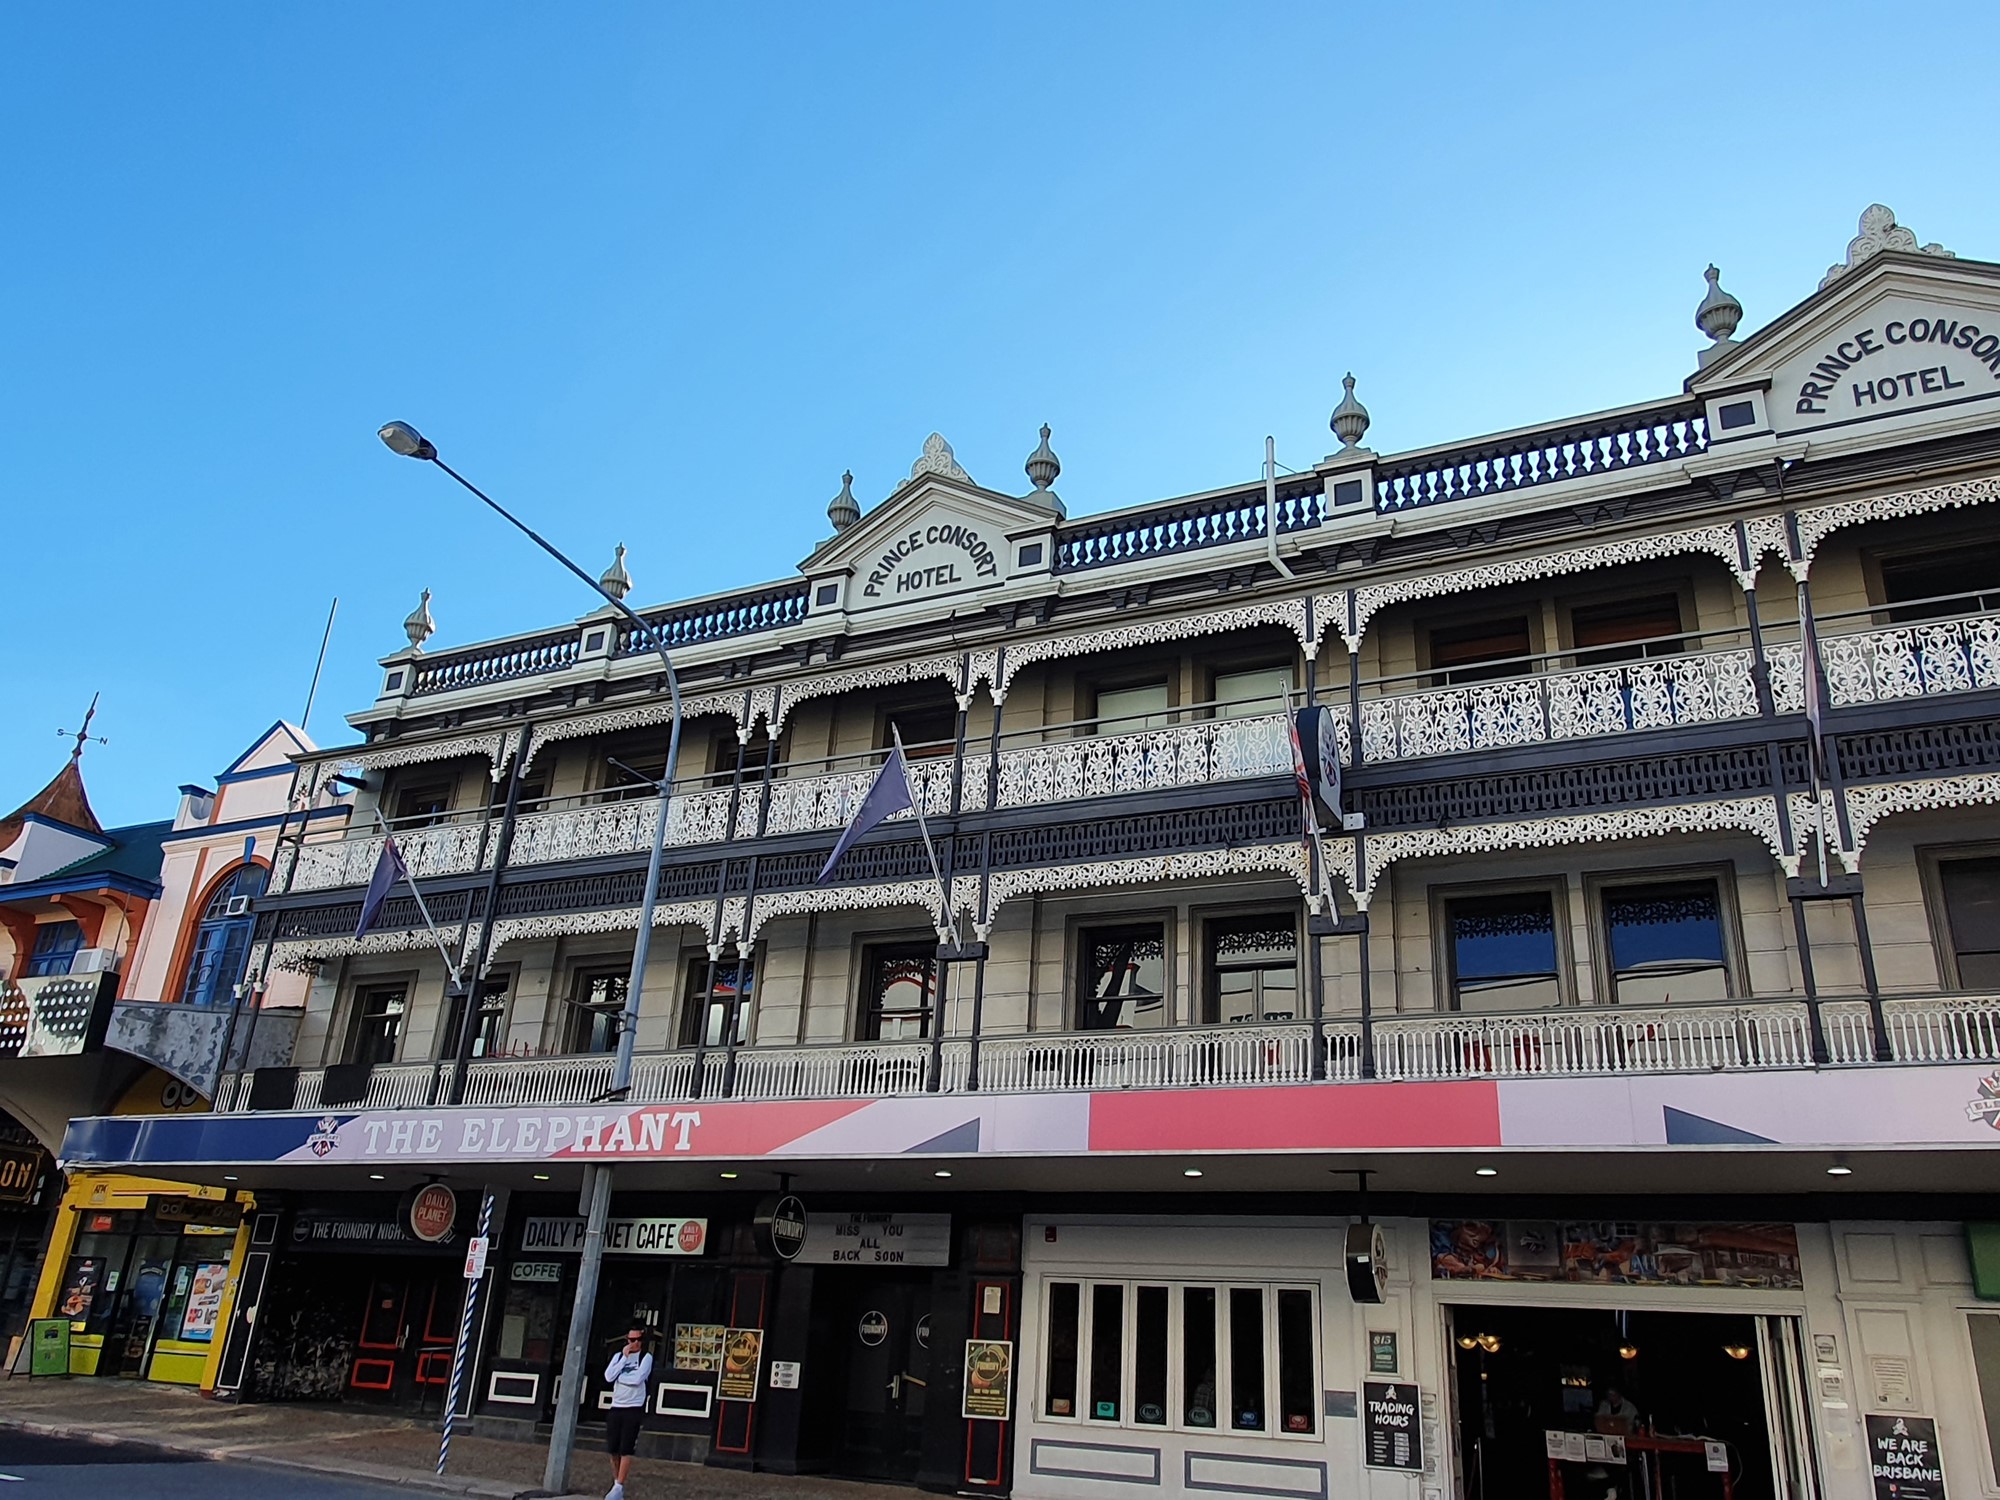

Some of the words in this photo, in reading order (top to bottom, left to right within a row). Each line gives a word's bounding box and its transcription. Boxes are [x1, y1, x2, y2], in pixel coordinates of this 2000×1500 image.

[1795, 328, 1884, 414] PRINCE
[1885, 318, 2000, 380] CONSO
[1853, 366, 1965, 407] HOTEL
[863, 530, 924, 597] PRINCE
[926, 524, 997, 578] CONSORT
[896, 564, 962, 593] HOTEL
[363, 1119, 444, 1155] THE
[459, 1111, 701, 1155] ELEPHANT
[0, 1160, 33, 1188] ON
[425, 1193, 450, 1209] DAILY
[417, 1207, 448, 1223] PLANET
[312, 1222, 333, 1239] THE
[331, 1222, 376, 1240] FOUNDRY
[525, 1221, 571, 1247] DAILY
[573, 1222, 635, 1249] PNET
[636, 1223, 677, 1249] CAFE
[683, 1225, 700, 1234] DAILY
[774, 1218, 804, 1240] FOUNDRY
[835, 1225, 860, 1237] MISS
[882, 1225, 904, 1237] YOU
[859, 1239, 881, 1249] ALL
[833, 1250, 861, 1262] BACK
[874, 1251, 905, 1262] SOON
[1368, 1400, 1415, 1416] TRADING
[1375, 1414, 1409, 1428] HOURS
[1877, 1437, 1898, 1450] WE
[1901, 1439, 1929, 1454] ARE
[1886, 1452, 1924, 1467] BACK
[1873, 1464, 1942, 1482] BRISBANE
